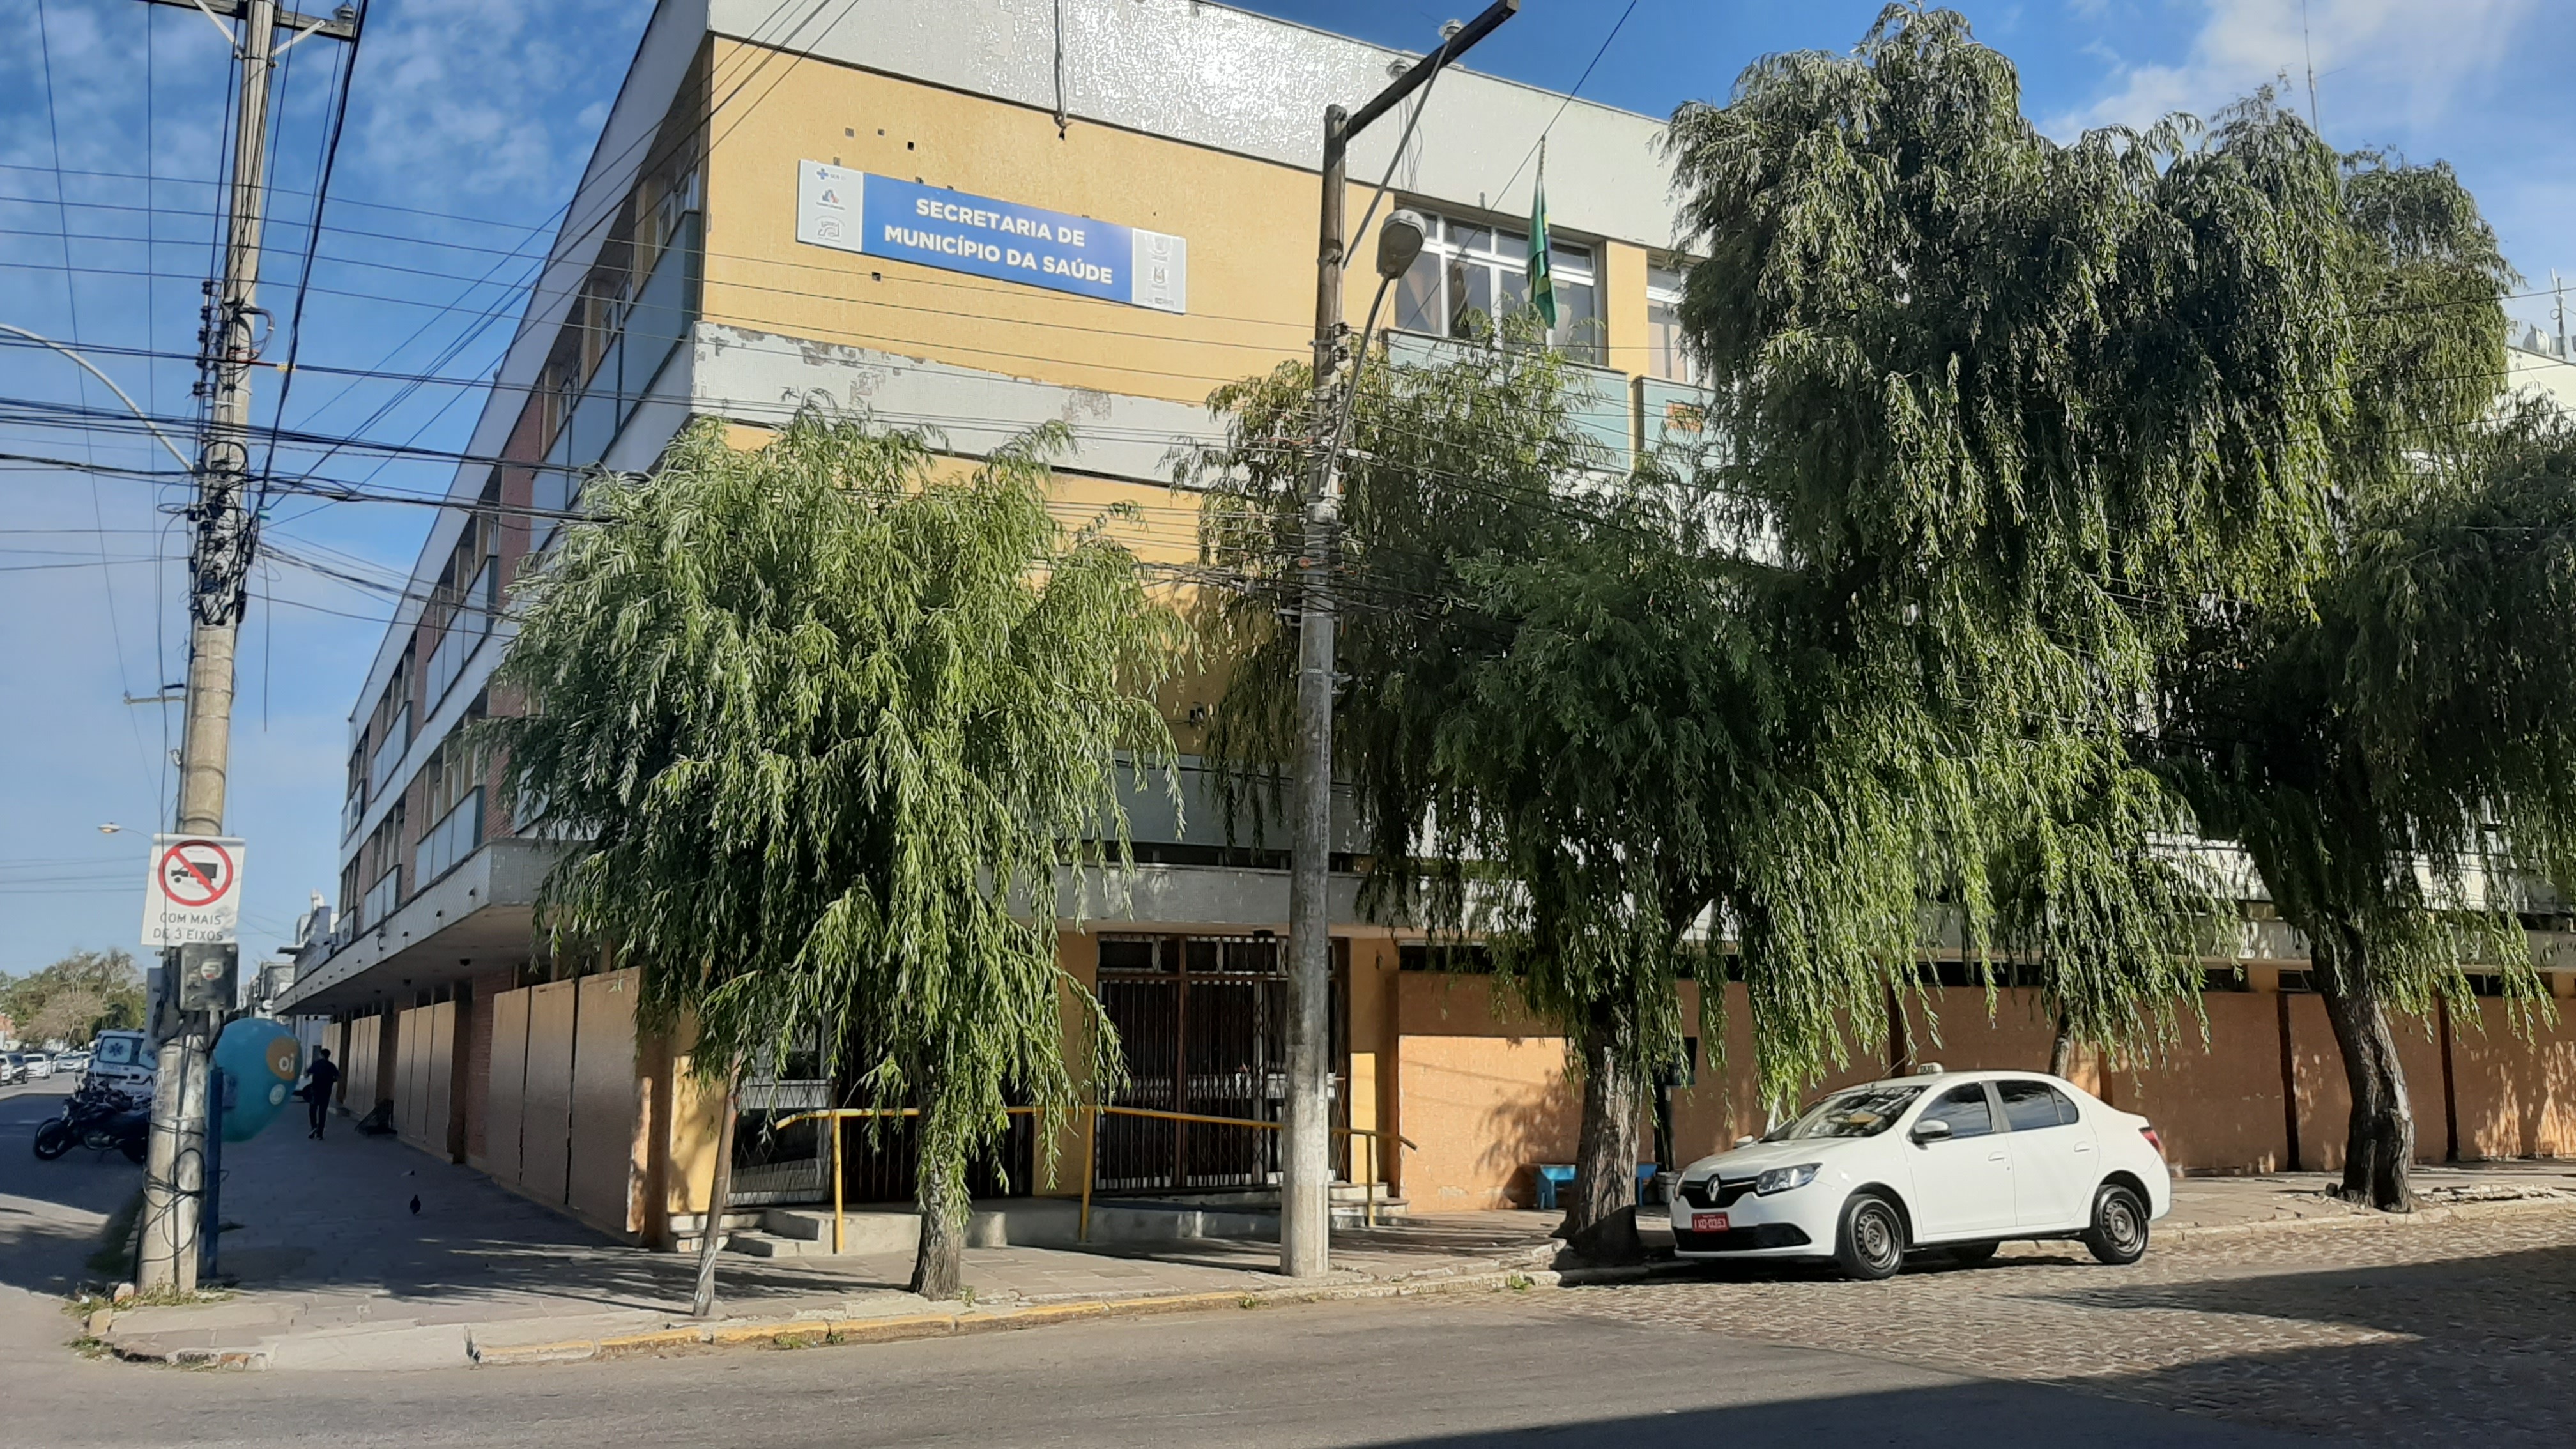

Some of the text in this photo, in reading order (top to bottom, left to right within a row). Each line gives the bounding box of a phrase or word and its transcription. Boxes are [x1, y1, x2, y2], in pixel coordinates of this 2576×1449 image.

[916, 199, 1085, 247] SECRETARIA DE
[885, 225, 1112, 284] MUNICÍPIO DA SAÚDE
[160, 912, 222, 925] COM MAIS
[153, 928, 224, 942] DE 3 EIXOS
[278, 1053, 295, 1073] oi
